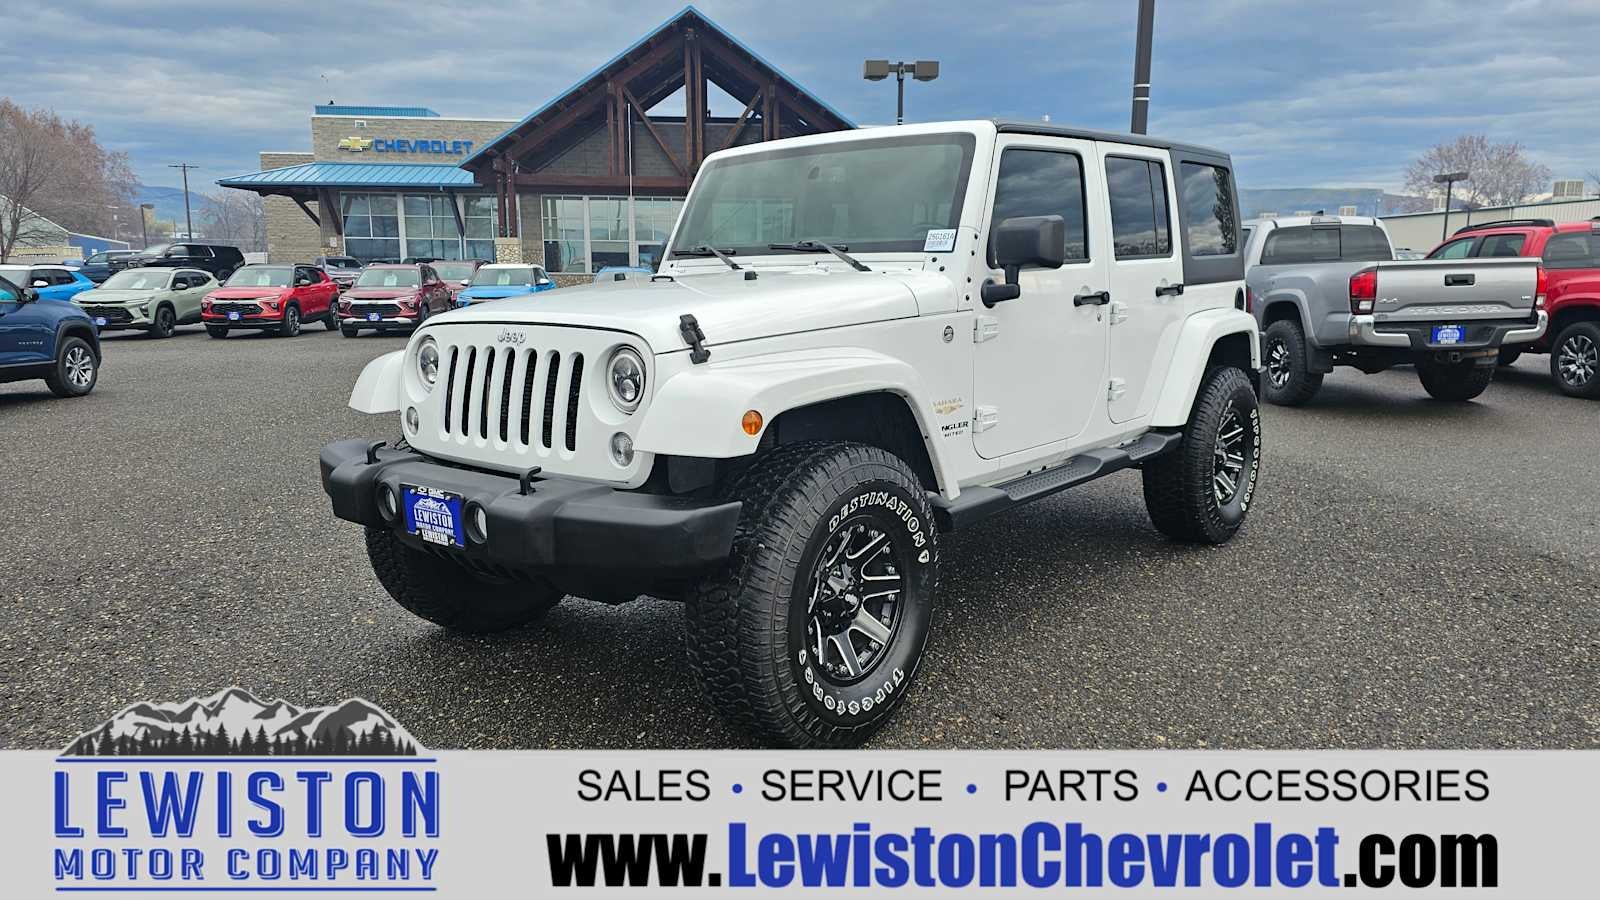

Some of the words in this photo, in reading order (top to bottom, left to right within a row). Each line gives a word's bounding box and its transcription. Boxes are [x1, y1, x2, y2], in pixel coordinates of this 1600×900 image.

[374, 138, 474, 153] CHEVROLET
[497, 327, 527, 346] Jeep
[414, 508, 454, 529] LEWISTON
[828, 491, 927, 548] DESTINATION
[803, 667, 905, 717] Firestone
